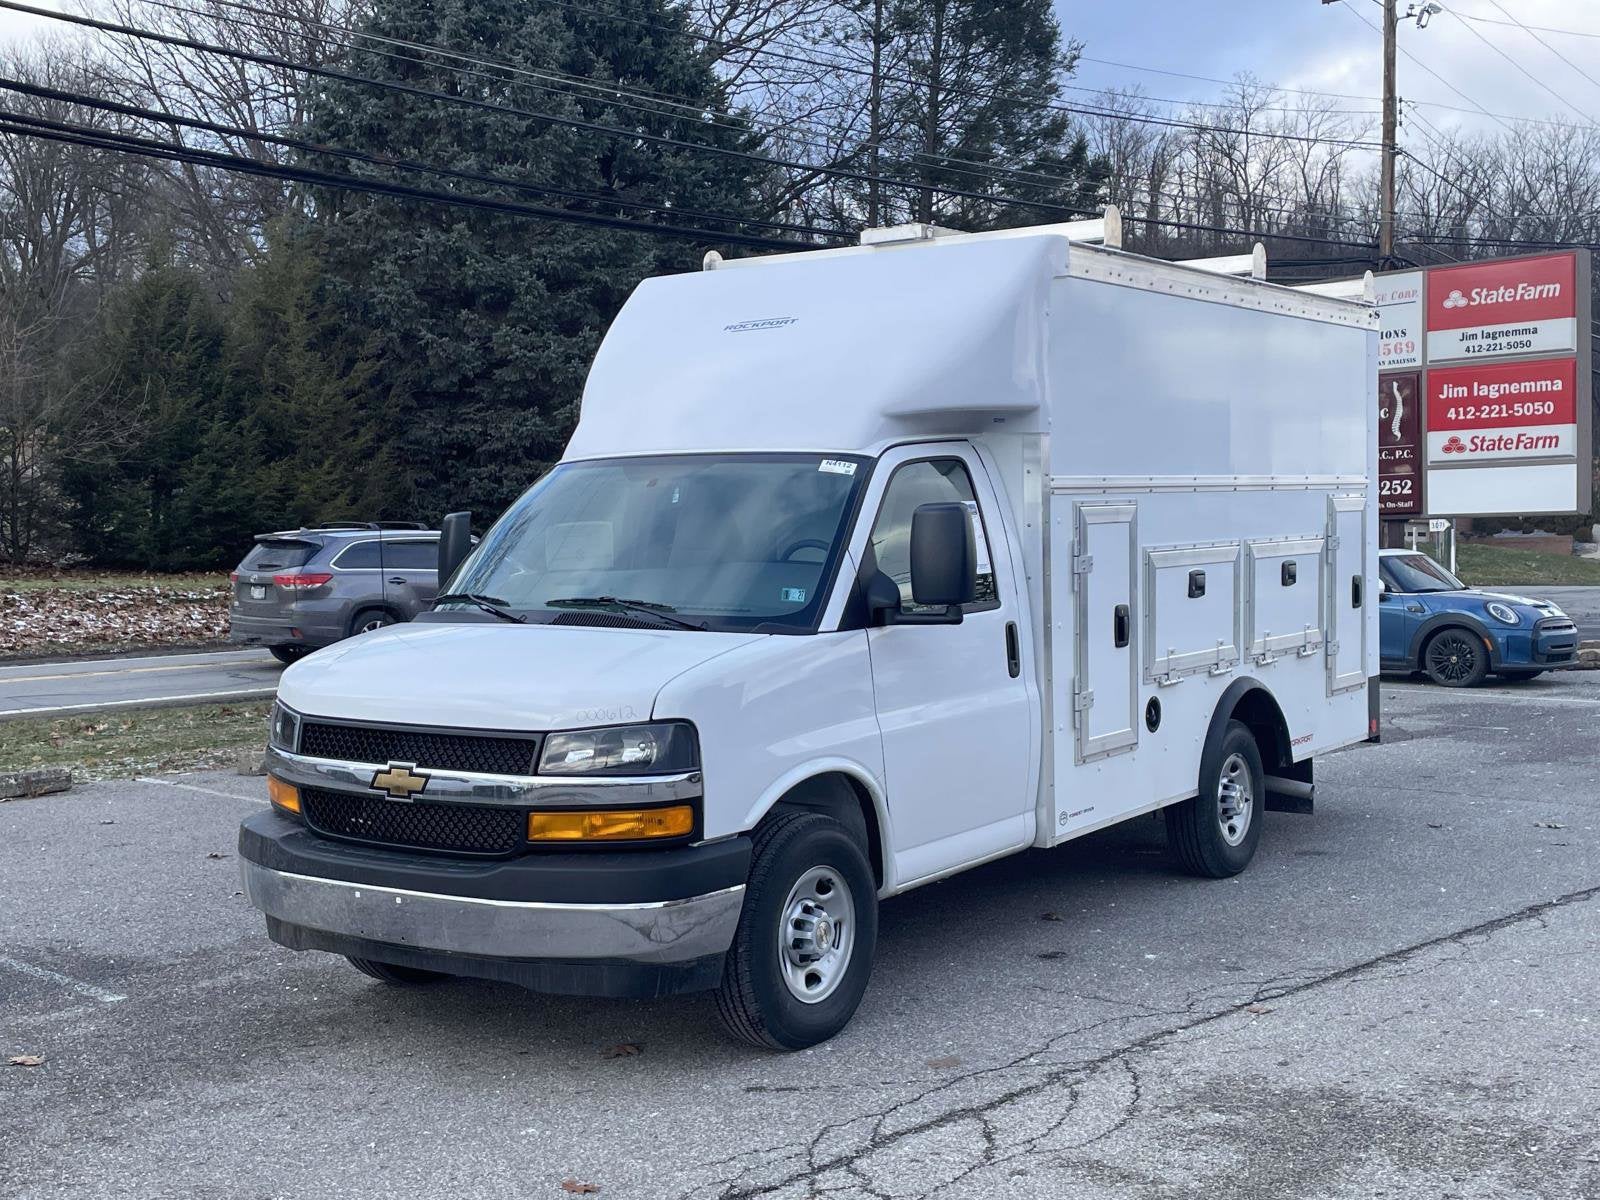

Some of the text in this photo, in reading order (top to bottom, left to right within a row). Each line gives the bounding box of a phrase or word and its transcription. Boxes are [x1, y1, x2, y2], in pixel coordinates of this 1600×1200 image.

[723, 318, 799, 331] ROCKPORT
[1380, 329, 1407, 340] IONS
[1459, 326, 1538, 342] Jim Iagnemma
[1378, 340, 1415, 356] 569
[1465, 340, 1532, 354] 412-221-5050
[1388, 357, 1417, 366] ANALYSIS
[1439, 379, 1563, 399] Jim Iagnemma
[1447, 402, 1555, 420] 412-221-5050
[1395, 449, 1413, 459] P.C.
[1378, 479, 1413, 495] 252
[1386, 500, 1414, 509] On-Staff
